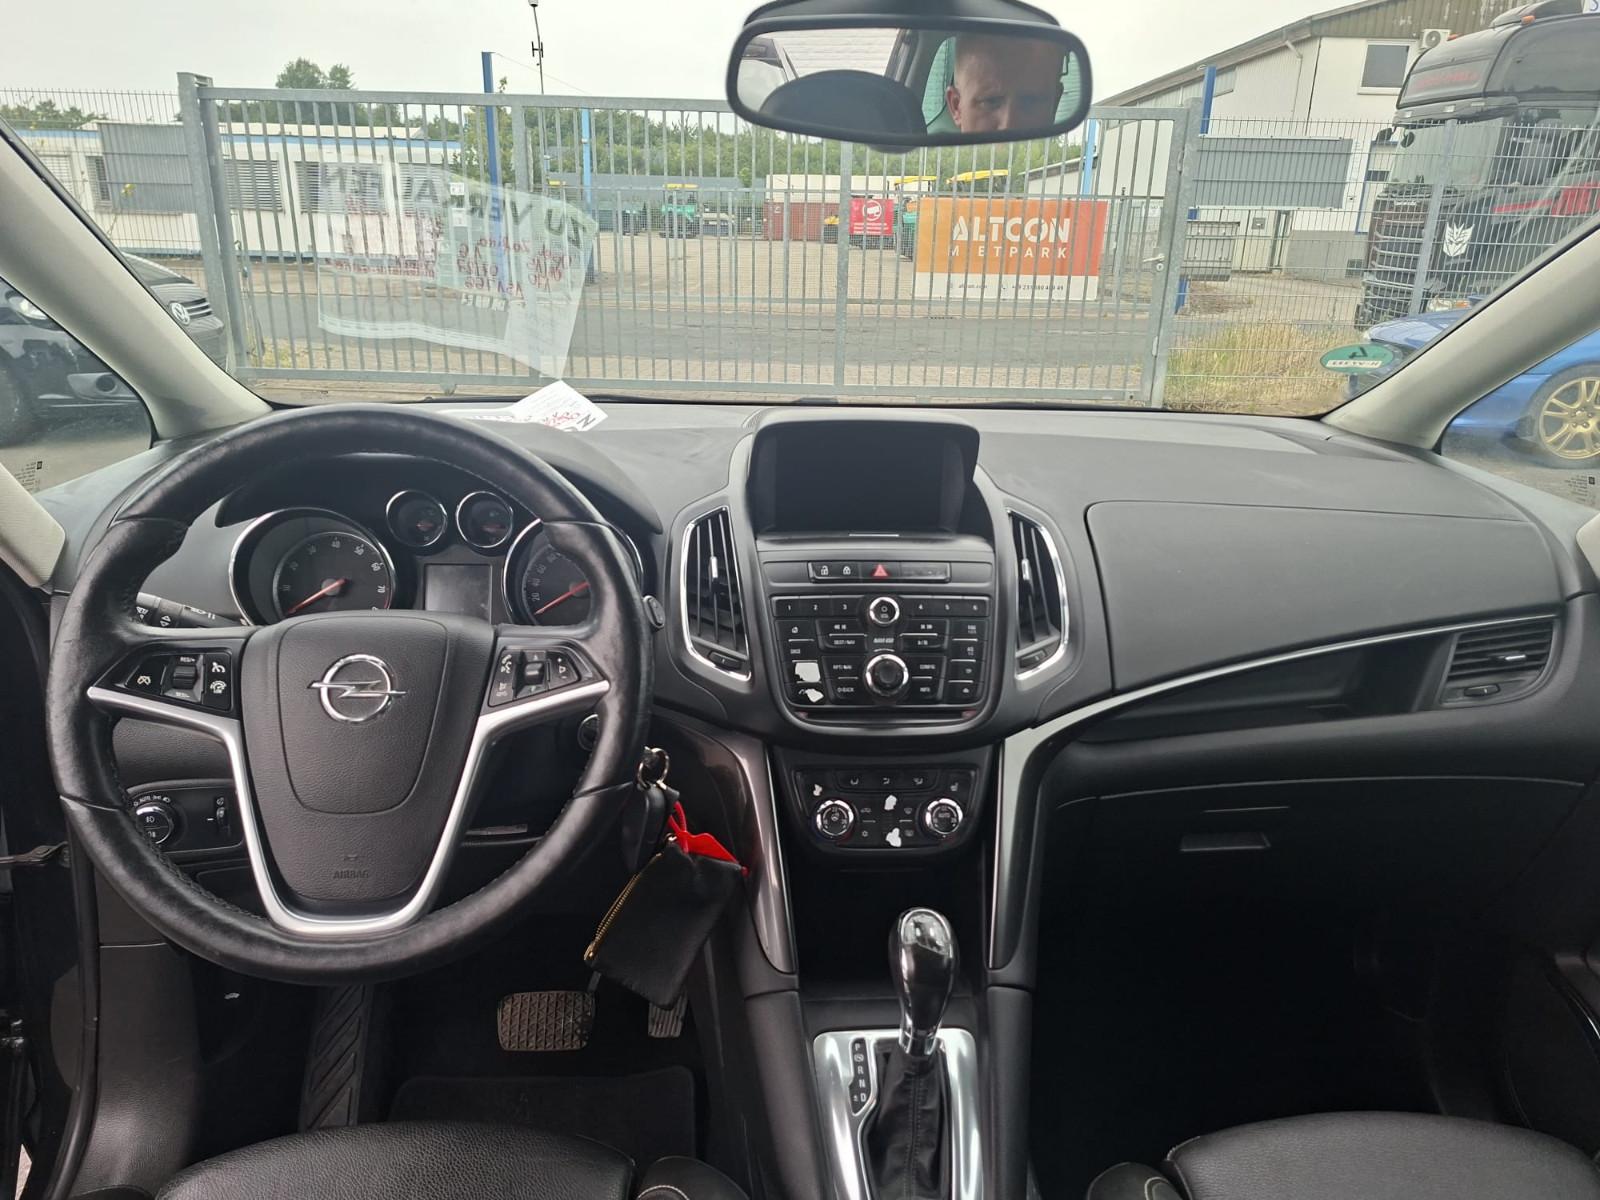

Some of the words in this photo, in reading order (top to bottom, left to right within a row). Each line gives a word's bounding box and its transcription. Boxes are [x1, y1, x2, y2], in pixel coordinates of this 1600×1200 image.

[952, 216, 1070, 243] ALTCON
[948, 246, 1067, 258] METPARK
[331, 540, 341, 549] 40
[854, 1043, 861, 1051] P
[857, 1065, 864, 1075] R
[859, 1079, 866, 1088] N
[860, 1092, 867, 1102] D
